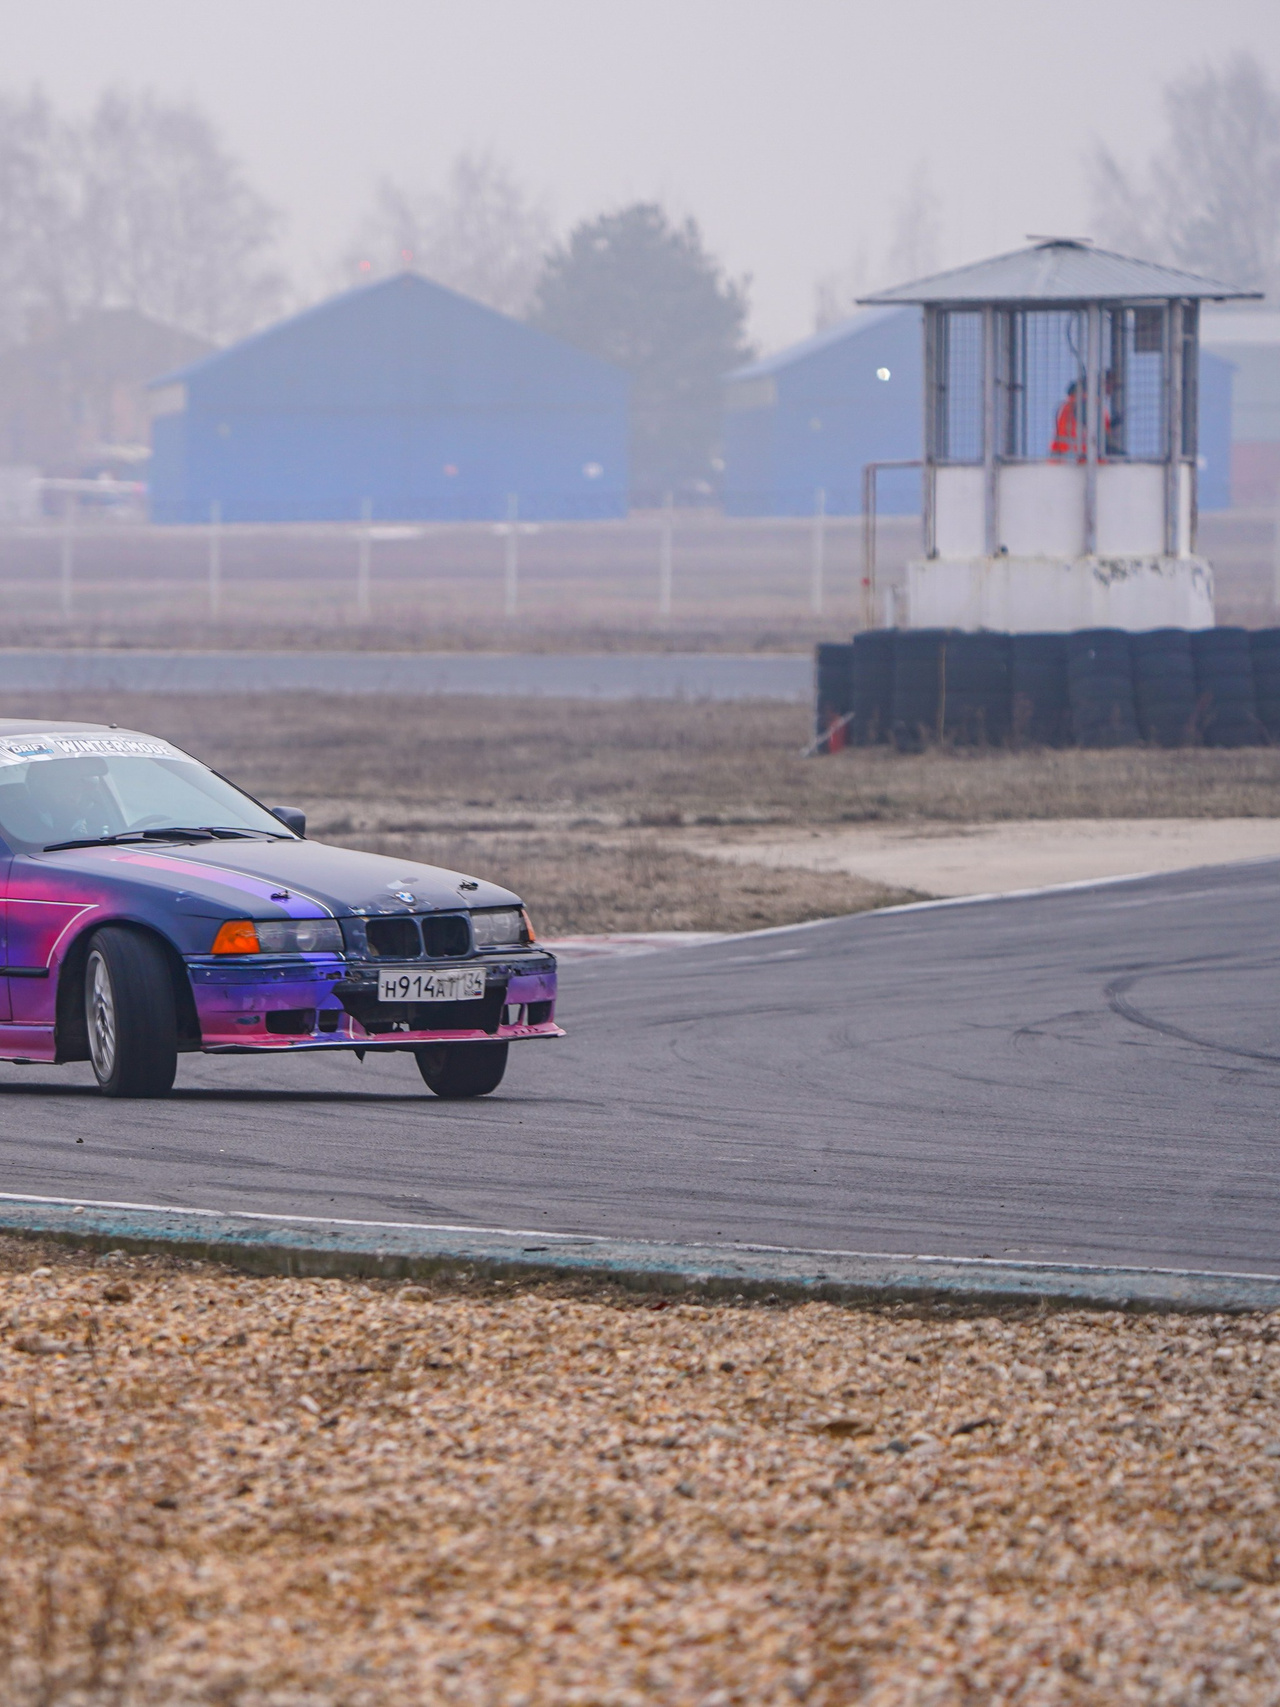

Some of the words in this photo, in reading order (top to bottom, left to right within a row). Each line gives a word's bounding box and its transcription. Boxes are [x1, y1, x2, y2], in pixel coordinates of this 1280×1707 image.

[8, 742, 48, 753] DRIFT
[54, 739, 127, 753] WINTER
[124, 741, 173, 755] MODE
